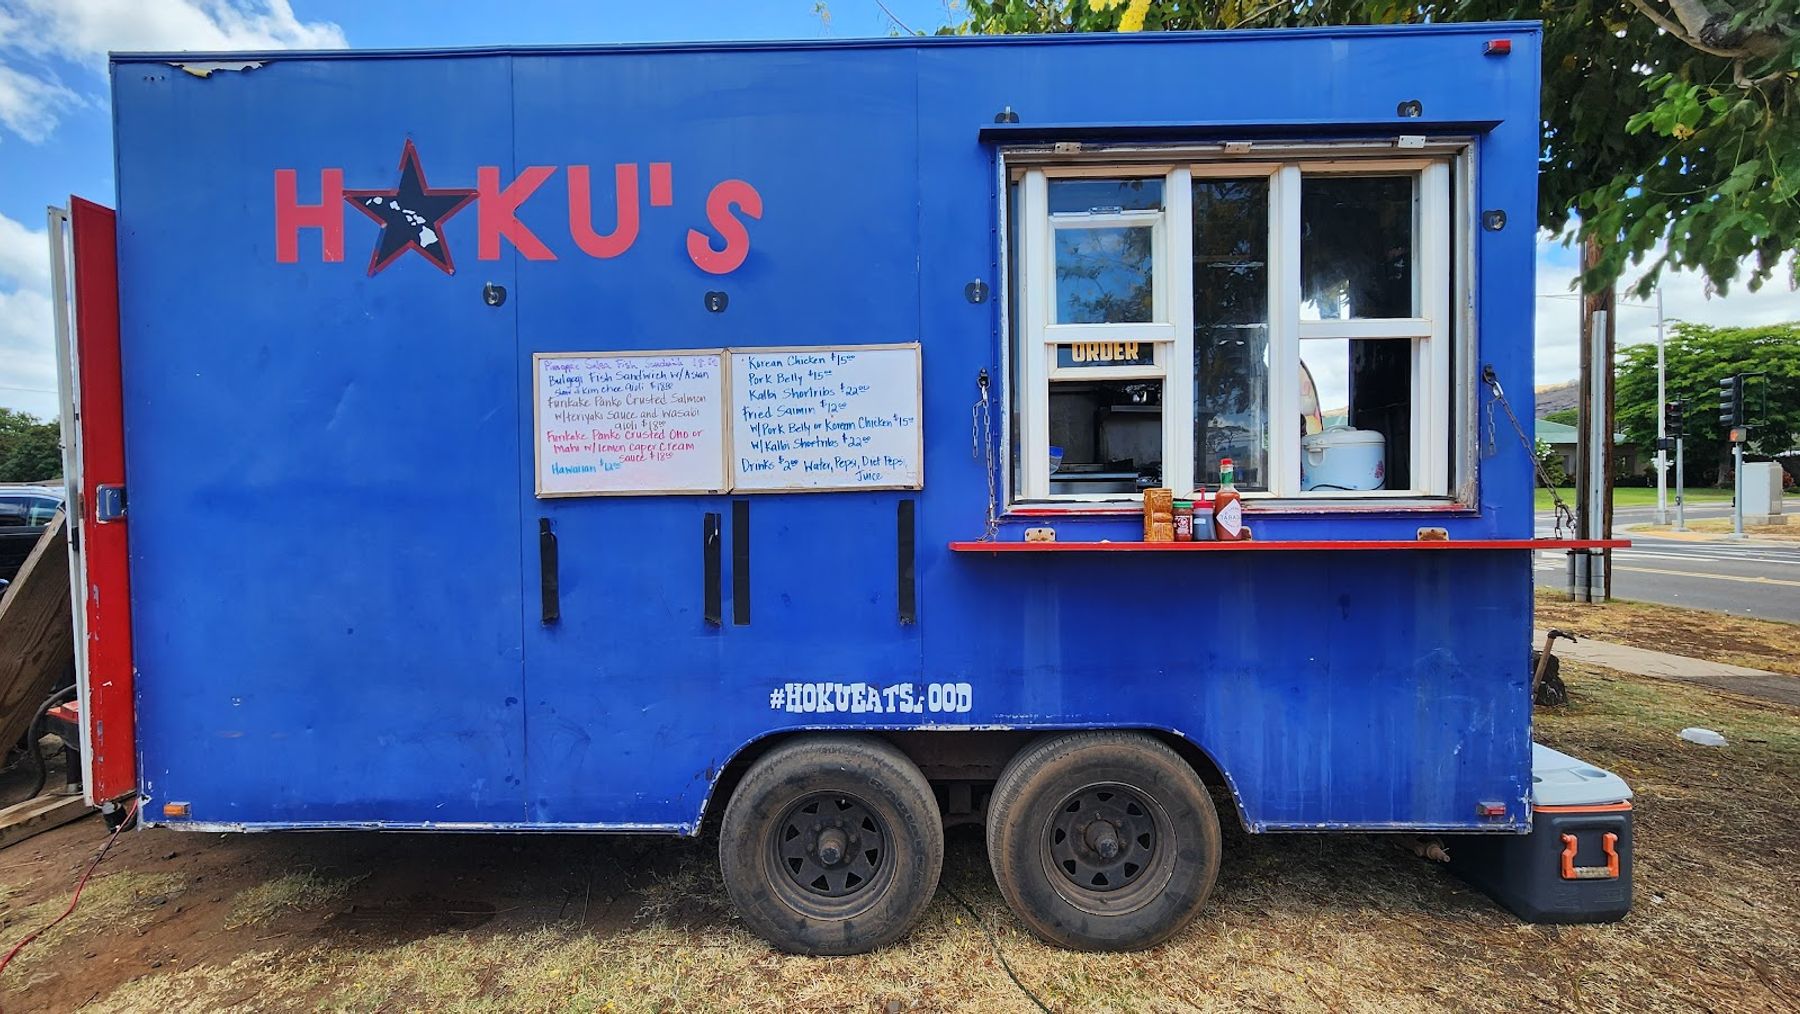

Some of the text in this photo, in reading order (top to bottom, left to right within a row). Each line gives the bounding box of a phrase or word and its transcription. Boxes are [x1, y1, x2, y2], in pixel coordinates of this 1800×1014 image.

[275, 138, 763, 277] HKU'S
[1072, 340, 1139, 362] ORDER
[615, 359, 638, 369] Fish
[748, 356, 783, 370] Korean
[787, 354, 825, 366] Chicken
[588, 372, 613, 383] Fish
[748, 373, 772, 386] Pork
[777, 371, 803, 385] Belly
[594, 395, 622, 407] Panko
[625, 393, 667, 406] Crusted
[671, 391, 706, 404] Salmon
[749, 389, 776, 401] Kalbi
[640, 408, 658, 418] and
[742, 405, 773, 420] Fried
[788, 421, 810, 436] Belly
[825, 418, 856, 431] Korean
[858, 416, 892, 428] Chicken
[692, 430, 703, 438] or
[741, 457, 774, 473] Drinks
[856, 470, 883, 482] Juice
[769, 682, 973, 714] #HOKUEATSOOD
